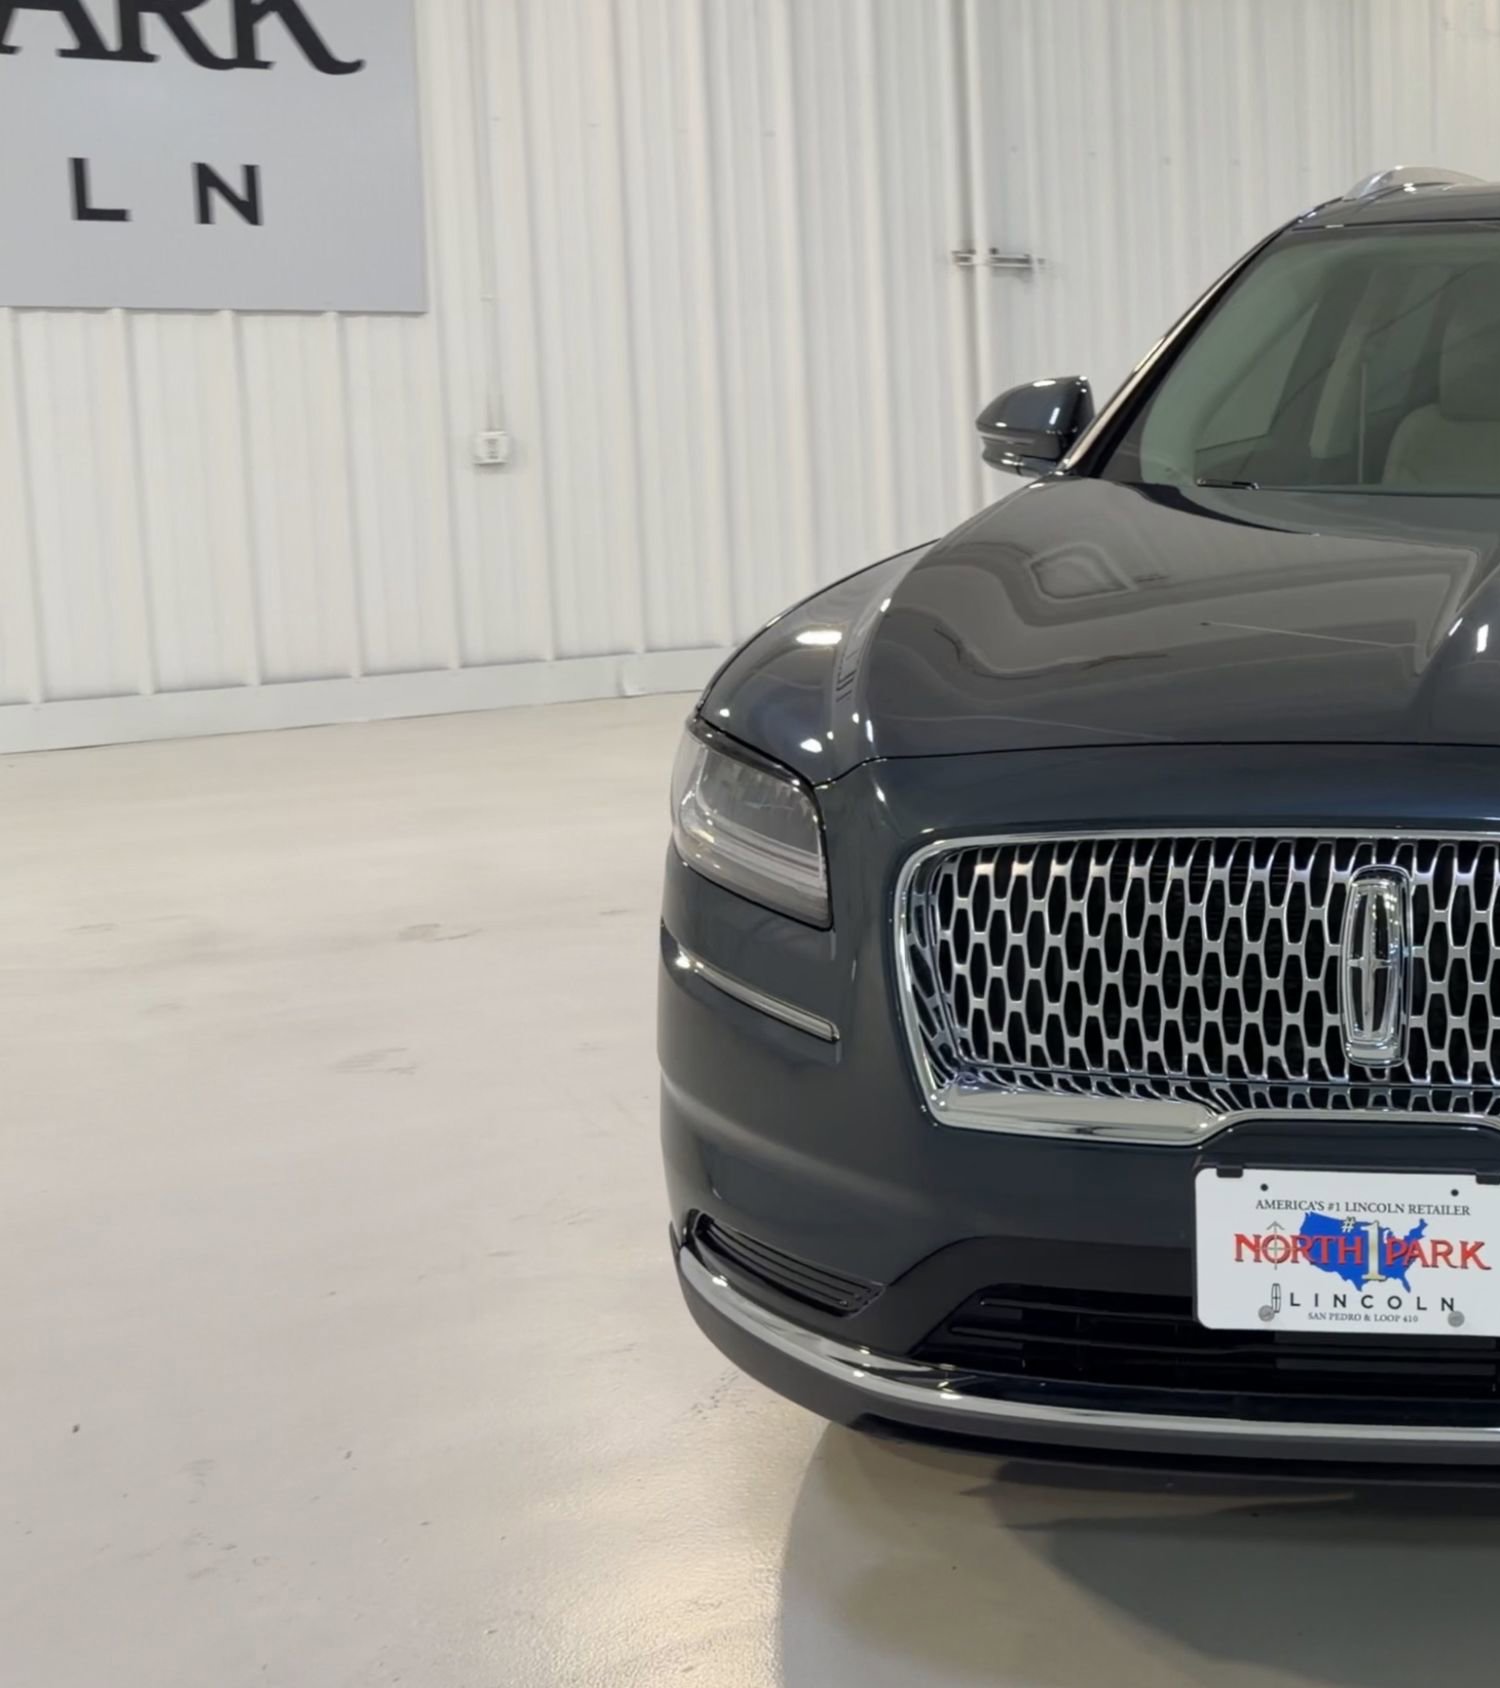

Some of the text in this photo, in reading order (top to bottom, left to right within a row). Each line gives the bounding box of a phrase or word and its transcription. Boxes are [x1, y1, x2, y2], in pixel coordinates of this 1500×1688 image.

[1256, 1199, 1471, 1216] AMERICA'S #1 LINCOLN RETAILER
[1234, 1233, 1492, 1270] NORTH PARK
[1289, 1292, 1455, 1312] LINCOLN
[1308, 1312, 1419, 1323] SAN PEDRO & LOOP 410
